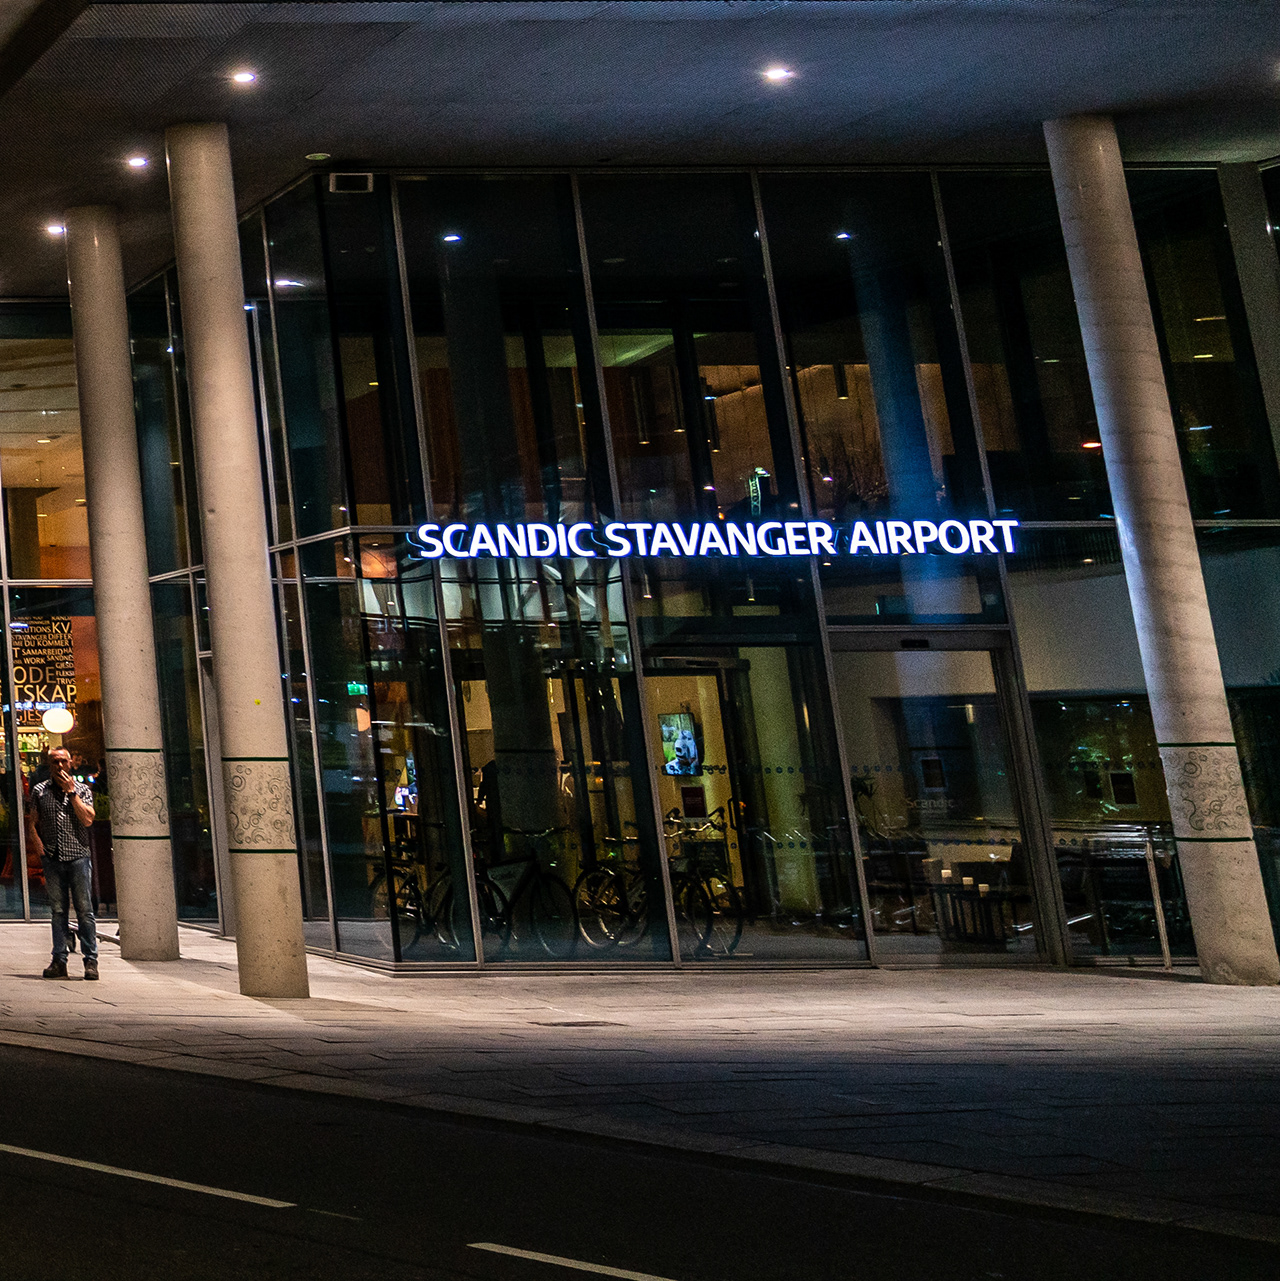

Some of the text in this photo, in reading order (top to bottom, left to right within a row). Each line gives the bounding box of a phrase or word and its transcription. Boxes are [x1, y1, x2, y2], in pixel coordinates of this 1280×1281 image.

[418, 519, 1019, 558] SCANDIC STAVANGER AIRPORT
[21, 648, 63, 656] SAMARBEID
[23, 656, 46, 664] WORK
